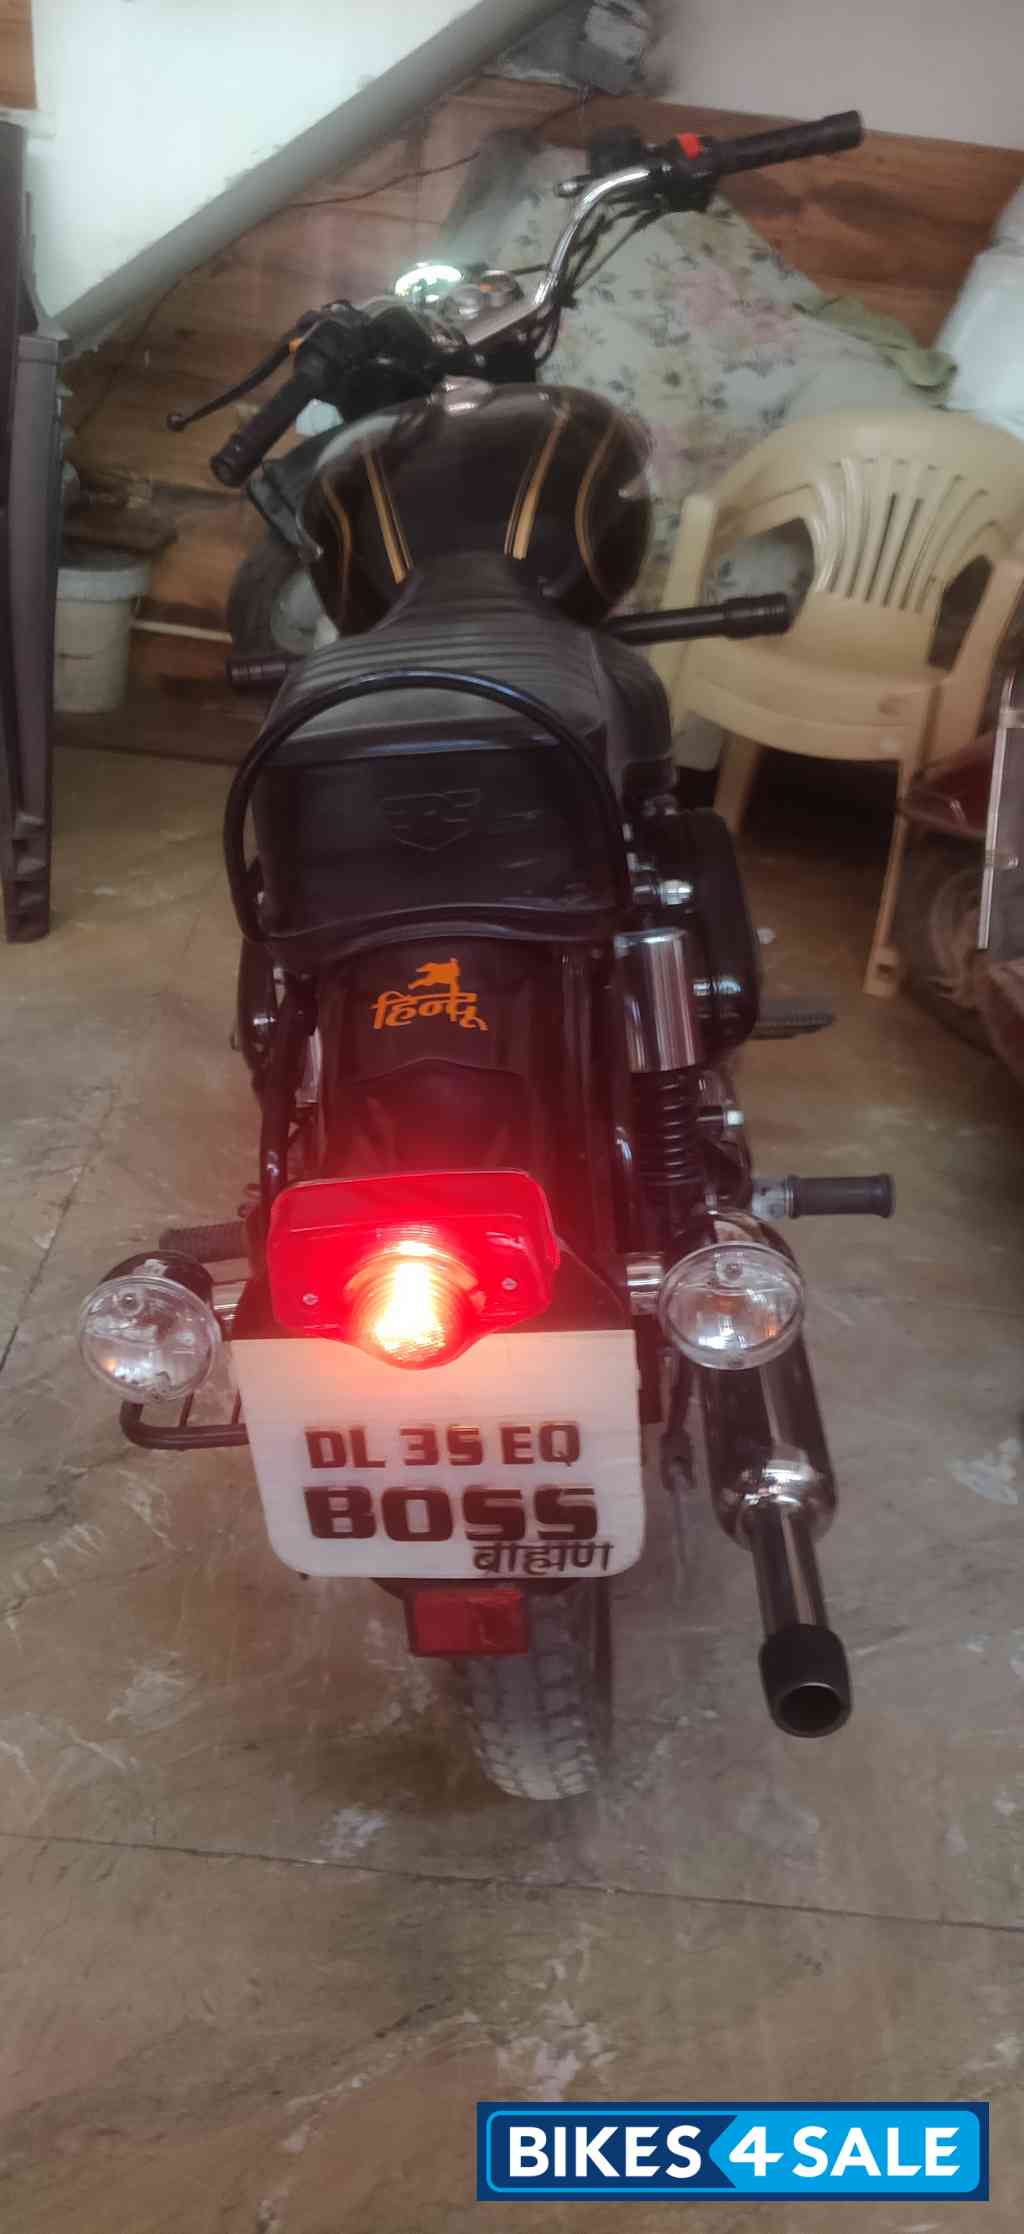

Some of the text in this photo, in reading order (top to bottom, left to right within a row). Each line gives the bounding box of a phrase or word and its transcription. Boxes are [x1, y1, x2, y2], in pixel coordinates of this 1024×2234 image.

[304, 1425, 386, 1469] DL
[500, 1421, 581, 1467] EQ
[304, 1486, 598, 1542] BOSS
